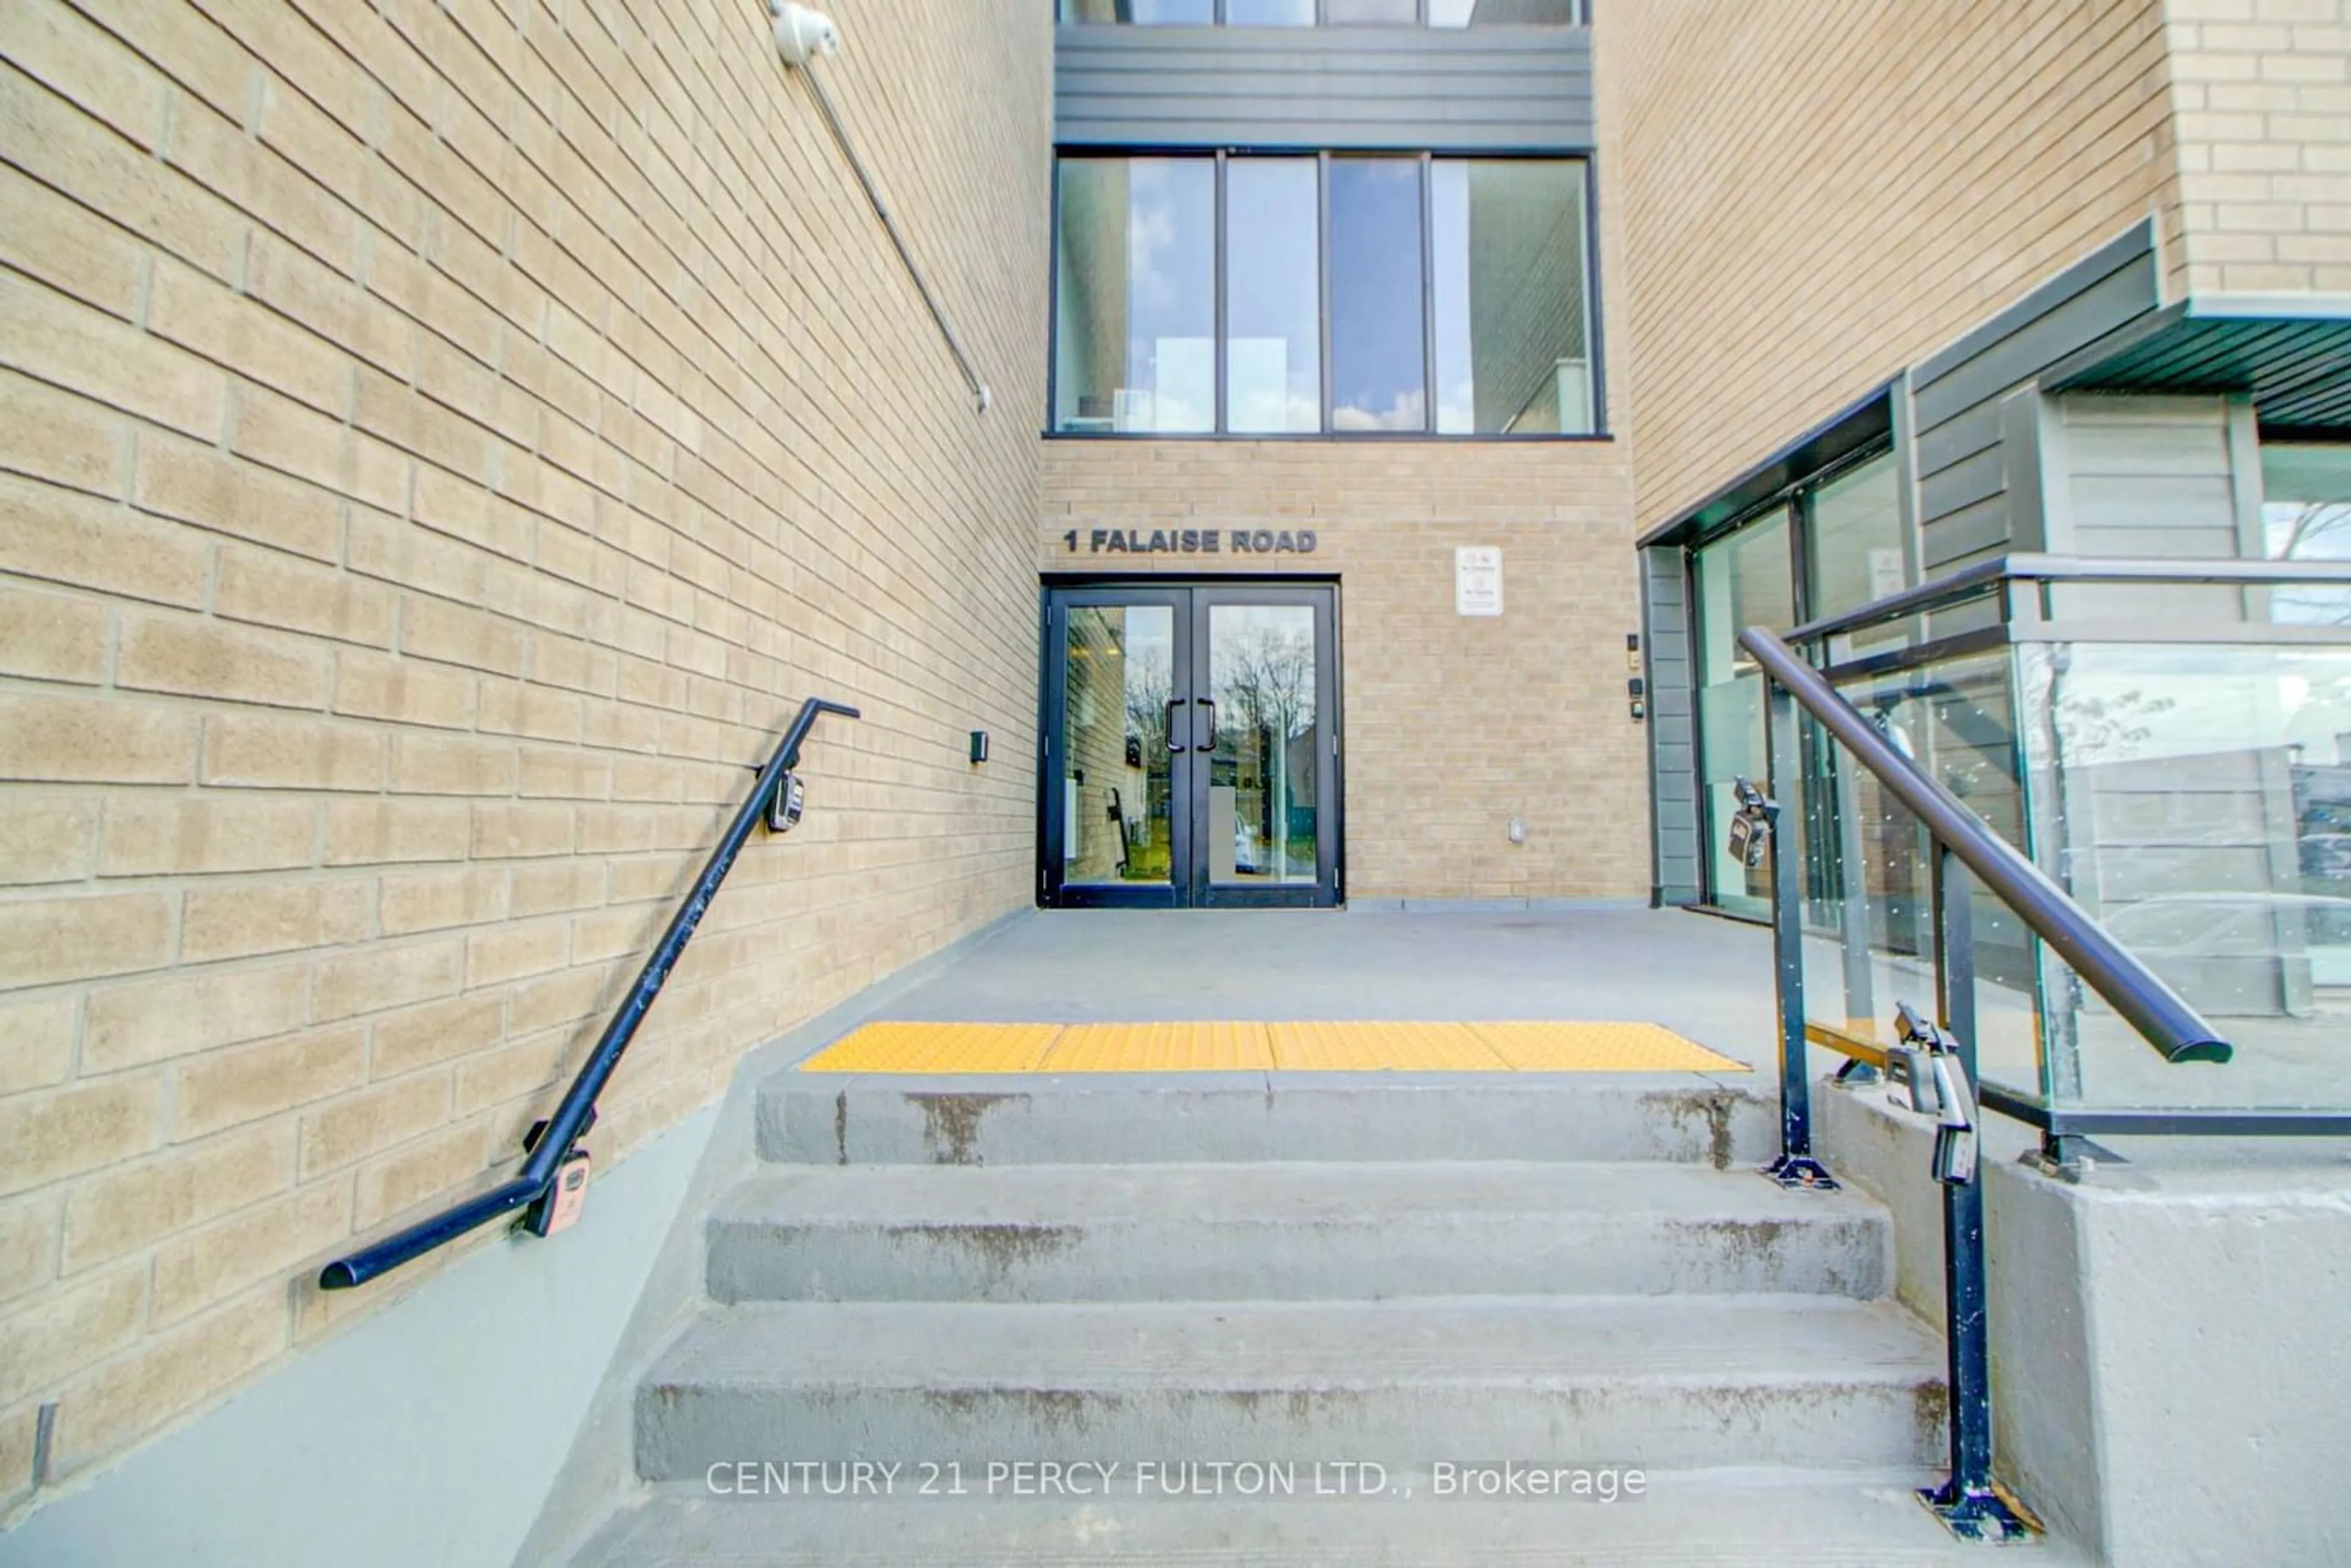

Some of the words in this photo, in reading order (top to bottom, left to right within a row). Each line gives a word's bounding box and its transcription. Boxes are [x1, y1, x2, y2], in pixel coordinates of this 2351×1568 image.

[1064, 529, 1078, 552] 1
[1091, 529, 1220, 552] FALAISE
[1231, 529, 1318, 553] ROAD
